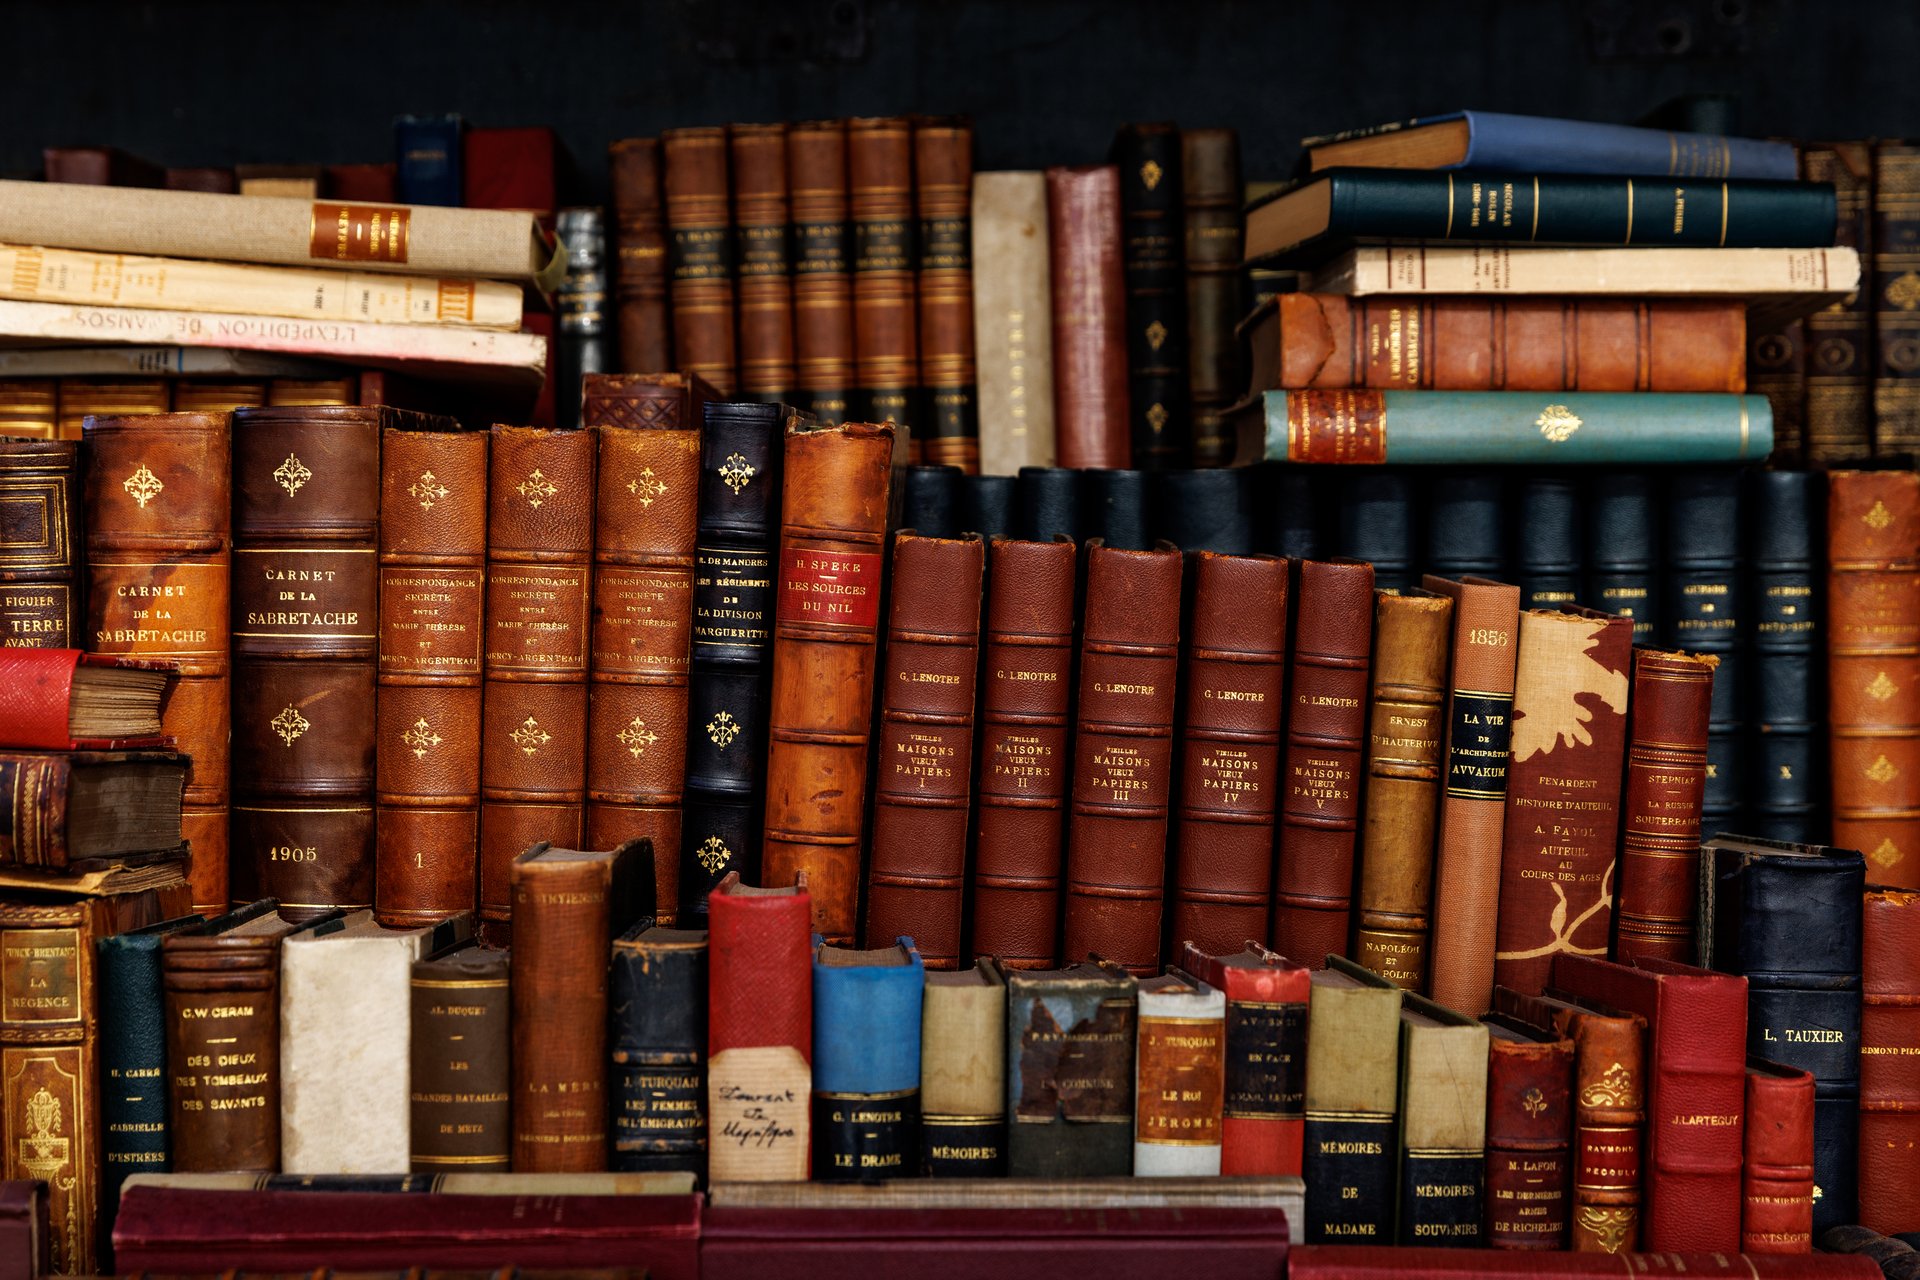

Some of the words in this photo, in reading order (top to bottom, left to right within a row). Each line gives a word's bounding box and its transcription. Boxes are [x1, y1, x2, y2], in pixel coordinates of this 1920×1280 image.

[708, 557, 721, 566] DE
[721, 558, 769, 568] MANDRES
[811, 560, 861, 573] SPEKE
[266, 569, 337, 582] CARNET
[490, 576, 580, 588] CORRESPONDANCE
[697, 577, 711, 587] LES
[716, 576, 770, 588] RÉGIMENTS
[386, 578, 477, 588] CORRESPONDANCE
[600, 577, 690, 589] CORRESPONDANCE
[788, 581, 809, 592] LES
[812, 583, 867, 596] SOURCES
[117, 585, 187, 598] CARNET
[279, 591, 296, 603] DE
[300, 591, 317, 603] LA
[6, 596, 55, 607] FIGUIER
[723, 596, 739, 605] DE
[626, 605, 652, 613] ENTRE
[698, 606, 710, 618] LA
[712, 608, 763, 620] DIVISION
[803, 601, 822, 612] DU
[827, 603, 854, 614] NIL
[133, 610, 150, 620] DE
[156, 609, 173, 620] LA
[247, 611, 359, 626] SABRETACHE
[11, 619, 65, 634] TERRE
[694, 625, 769, 640] MARGUERITTE
[4, 637, 44, 648] AVANT
[96, 629, 208, 644] SABRETACHE
[526, 637, 538, 645] ET
[1468, 628, 1509, 648] 1856
[419, 641, 432, 649] ET
[912, 672, 961, 685] LENOTRE
[1009, 670, 1058, 682] LENOTRE
[1106, 683, 1156, 697] LENOTRE
[1217, 690, 1266, 703] LENOTRE
[1311, 695, 1360, 708] LENOTRE
[1389, 715, 1430, 729] ERNEST
[1463, 713, 1480, 726] LA
[1485, 715, 1505, 726] VIE
[910, 733, 943, 743] VIEILLES
[1006, 735, 1040, 744] VIEILLES
[1371, 734, 1440, 749] D'HAUTERIVE
[1477, 735, 1491, 744] DE
[896, 742, 954, 757] MAISONS
[994, 743, 1052, 756] MAISONS
[1105, 746, 1139, 756] VIEILLES
[1214, 748, 1248, 758] VIEILLES
[910, 756, 938, 767] VIEUX
[1009, 755, 1037, 765] VIEUX
[1093, 754, 1151, 768] MAISONS
[1201, 757, 1259, 771] MAISONS
[1307, 758, 1340, 768] VIEILLES
[895, 764, 952, 778] PAPIERS
[994, 765, 1051, 777] PAPIERS
[1106, 767, 1135, 778] VIEUX
[1216, 769, 1244, 780] VIEUX
[1294, 766, 1351, 781] MAISONS
[1451, 764, 1506, 778] AVVAKUM
[919, 777, 926, 789] I
[1017, 777, 1029, 789] II
[1092, 777, 1149, 790] PAPIERS
[1203, 778, 1260, 792] PAPIERS
[1307, 779, 1337, 790] VIEUX
[1538, 776, 1599, 790] FENARDENT
[1112, 789, 1130, 802] III
[1223, 792, 1240, 804] IV
[1293, 785, 1350, 800] PAPIERS
[1315, 798, 1325, 810] V
[1515, 796, 1564, 811] HISTOIRE
[1564, 800, 1613, 812] D'AUTEUIL
[1647, 799, 1661, 810] LA
[1664, 800, 1695, 811] RUSSIE
[1635, 814, 1700, 828] SOUTERRAINE
[1552, 824, 1597, 838] FAYOL
[270, 846, 317, 863] 1905
[1540, 845, 1589, 858] AUTEUIL
[1558, 859, 1573, 870] AU
[1520, 869, 1556, 882] COURS
[1558, 871, 1577, 882] DES
[1365, 941, 1420, 955] NAPOLÉON
[1384, 957, 1398, 967] ET
[1382, 969, 1419, 981] POLICE
[29, 977, 48, 989] LA
[1166, 1034, 1217, 1050] TURQUAN
[1763, 1029, 1778, 1043] L.
[1785, 1029, 1845, 1044] TAUXIER
[1860, 1046, 1900, 1056] EDMOND
[187, 1055, 212, 1068] DES
[217, 1052, 257, 1067] DIEUX
[449, 1060, 469, 1071] LES
[175, 1075, 197, 1088] DES
[202, 1072, 269, 1087] TOMBEAUX
[529, 1081, 550, 1094] LA
[718, 1086, 796, 1103] Laurent
[1161, 1090, 1178, 1102] LE
[1181, 1089, 1202, 1103] ROI
[182, 1099, 205, 1112] DES
[209, 1095, 267, 1111] SAVANTS
[651, 1099, 698, 1112] FEMMES
[850, 1110, 902, 1124] LENOTRE
[109, 1122, 165, 1133] GABRIELLE
[931, 1144, 998, 1161] MÉMOIRES
[1586, 1144, 1635, 1154] RAYMOND
[834, 1154, 854, 1168] LE
[860, 1153, 902, 1168] DRAME
[1341, 1186, 1360, 1201] DE
[1496, 1189, 1515, 1200] LES
[1518, 1206, 1548, 1217] ARMES
[1324, 1222, 1378, 1237] MADAME
[1494, 1221, 1510, 1233] DE
[1512, 1221, 1564, 1234] RICHELIEU
